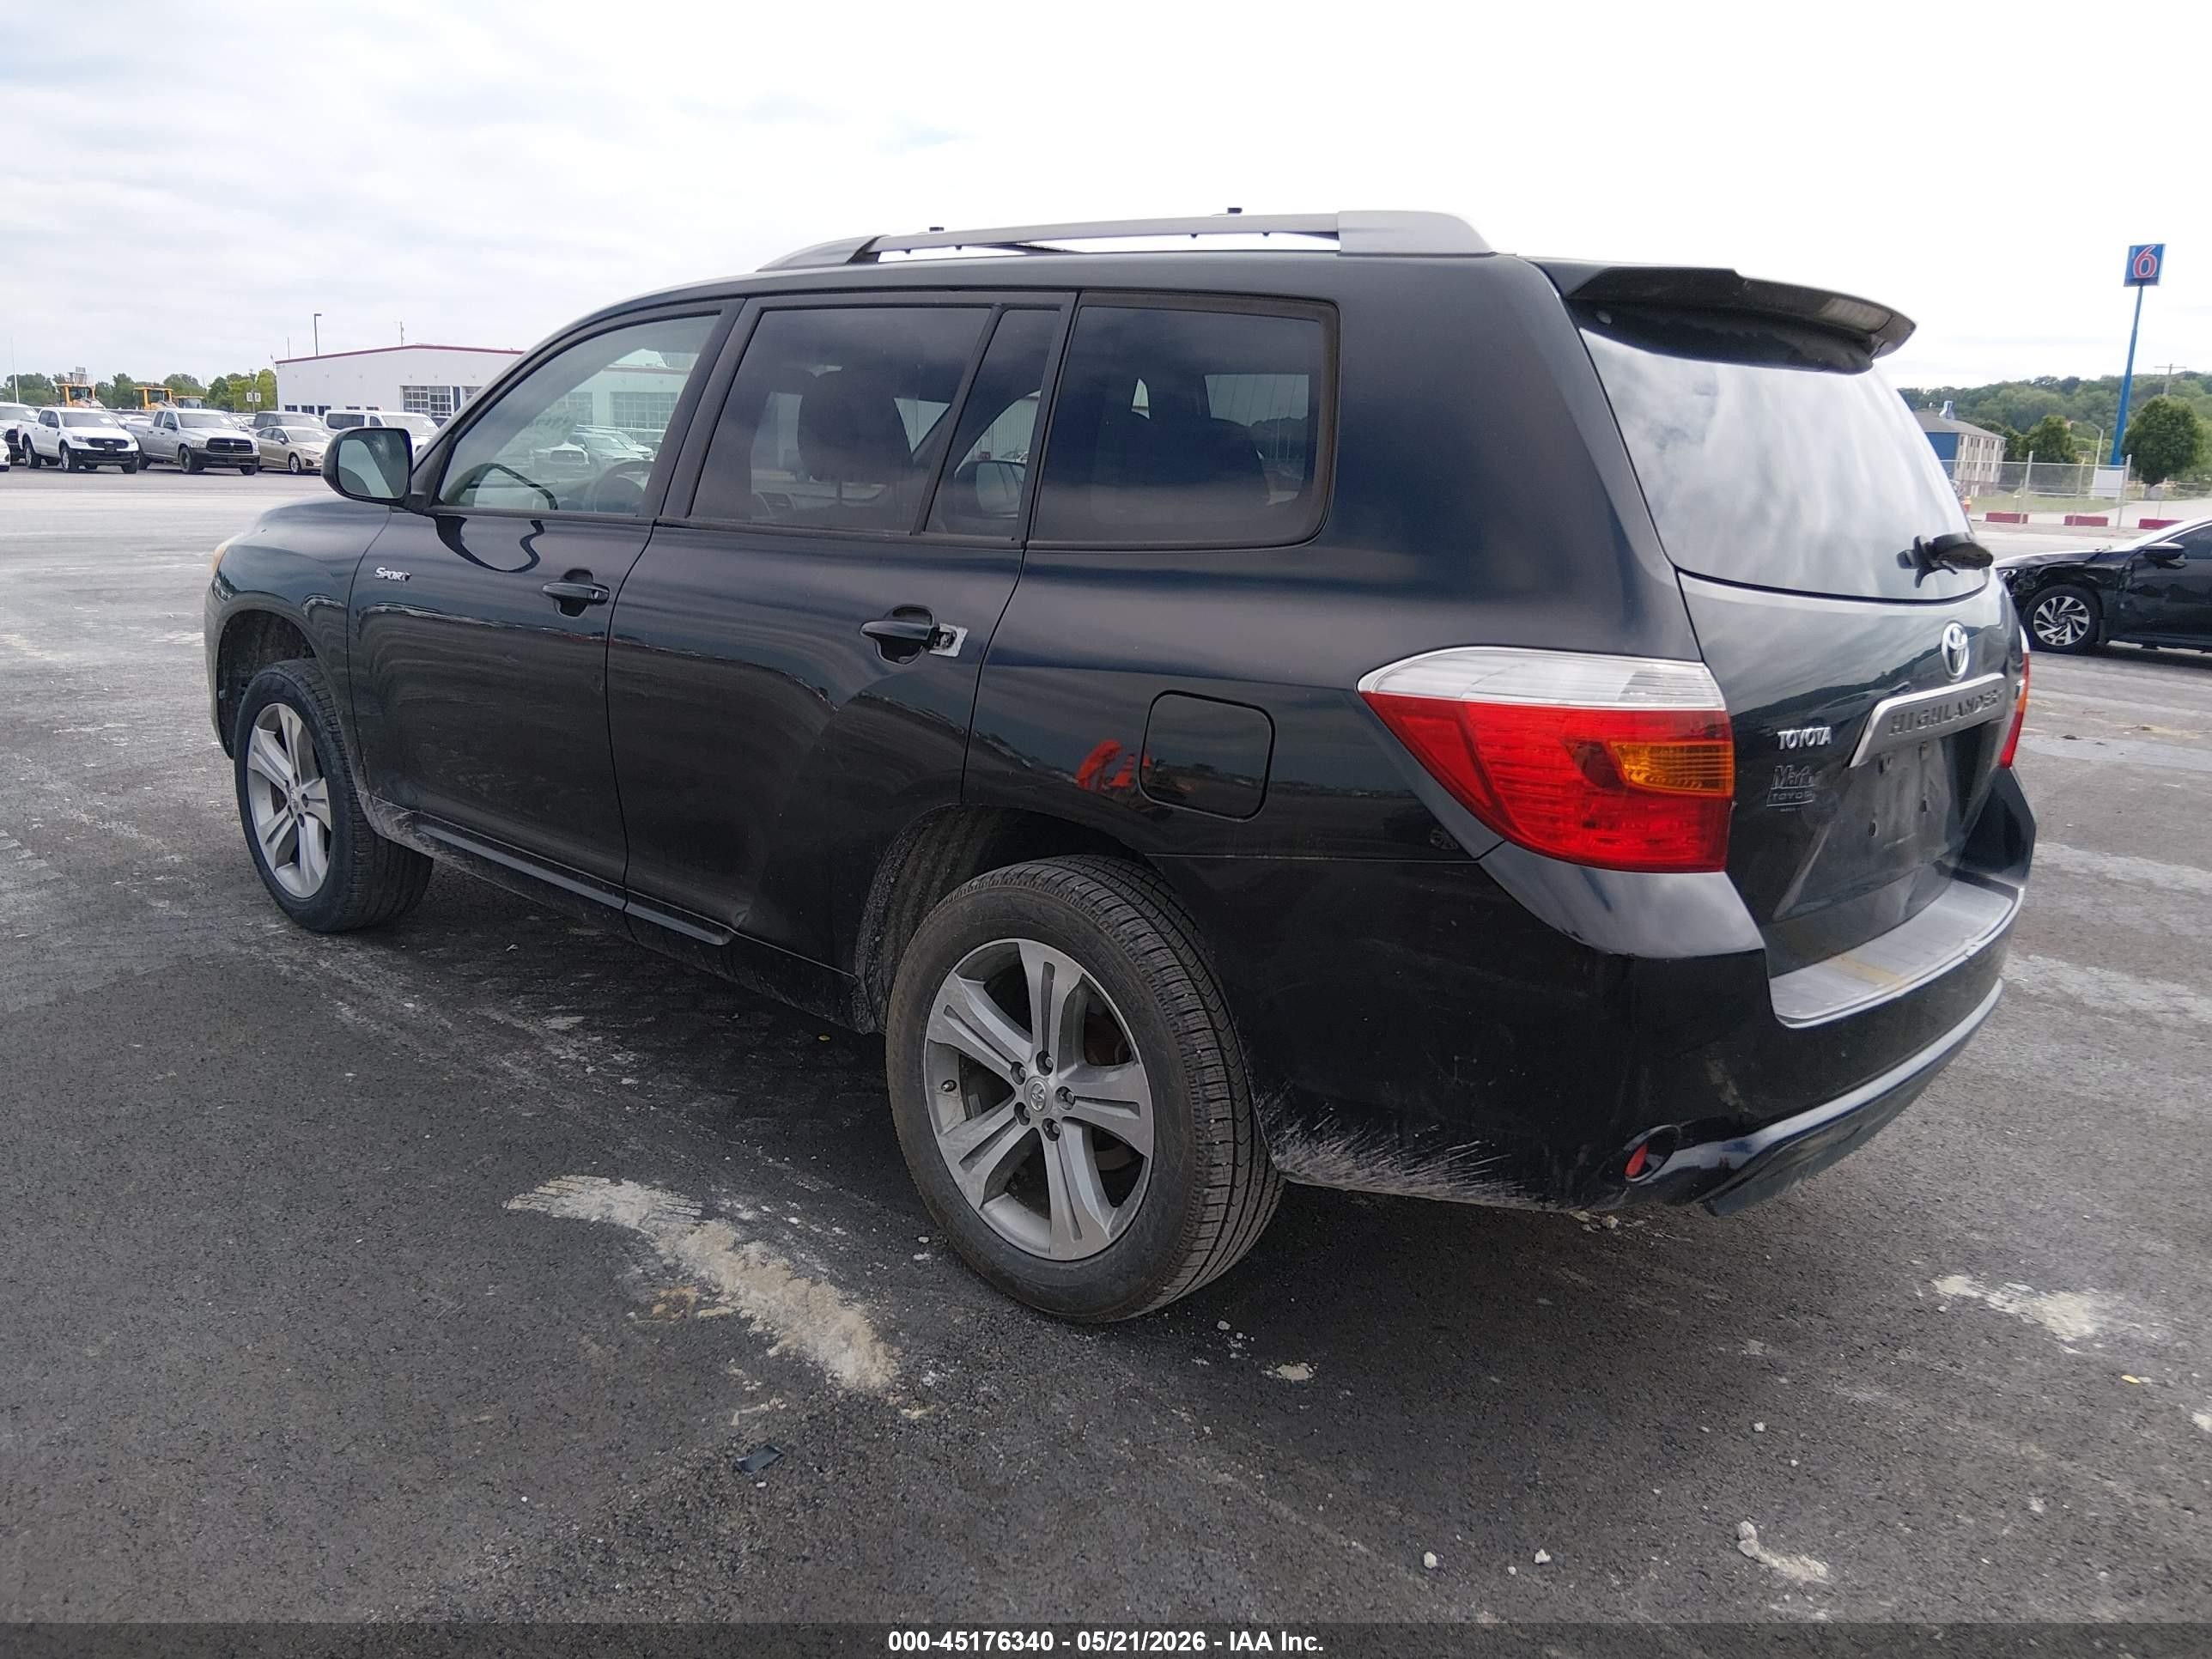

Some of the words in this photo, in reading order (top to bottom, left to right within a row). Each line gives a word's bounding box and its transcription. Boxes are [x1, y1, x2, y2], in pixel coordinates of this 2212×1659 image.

[2133, 245, 2157, 278] 6
[1888, 690, 2004, 736] HIGHLANDER
[1777, 726, 1831, 750] TOYOTA
